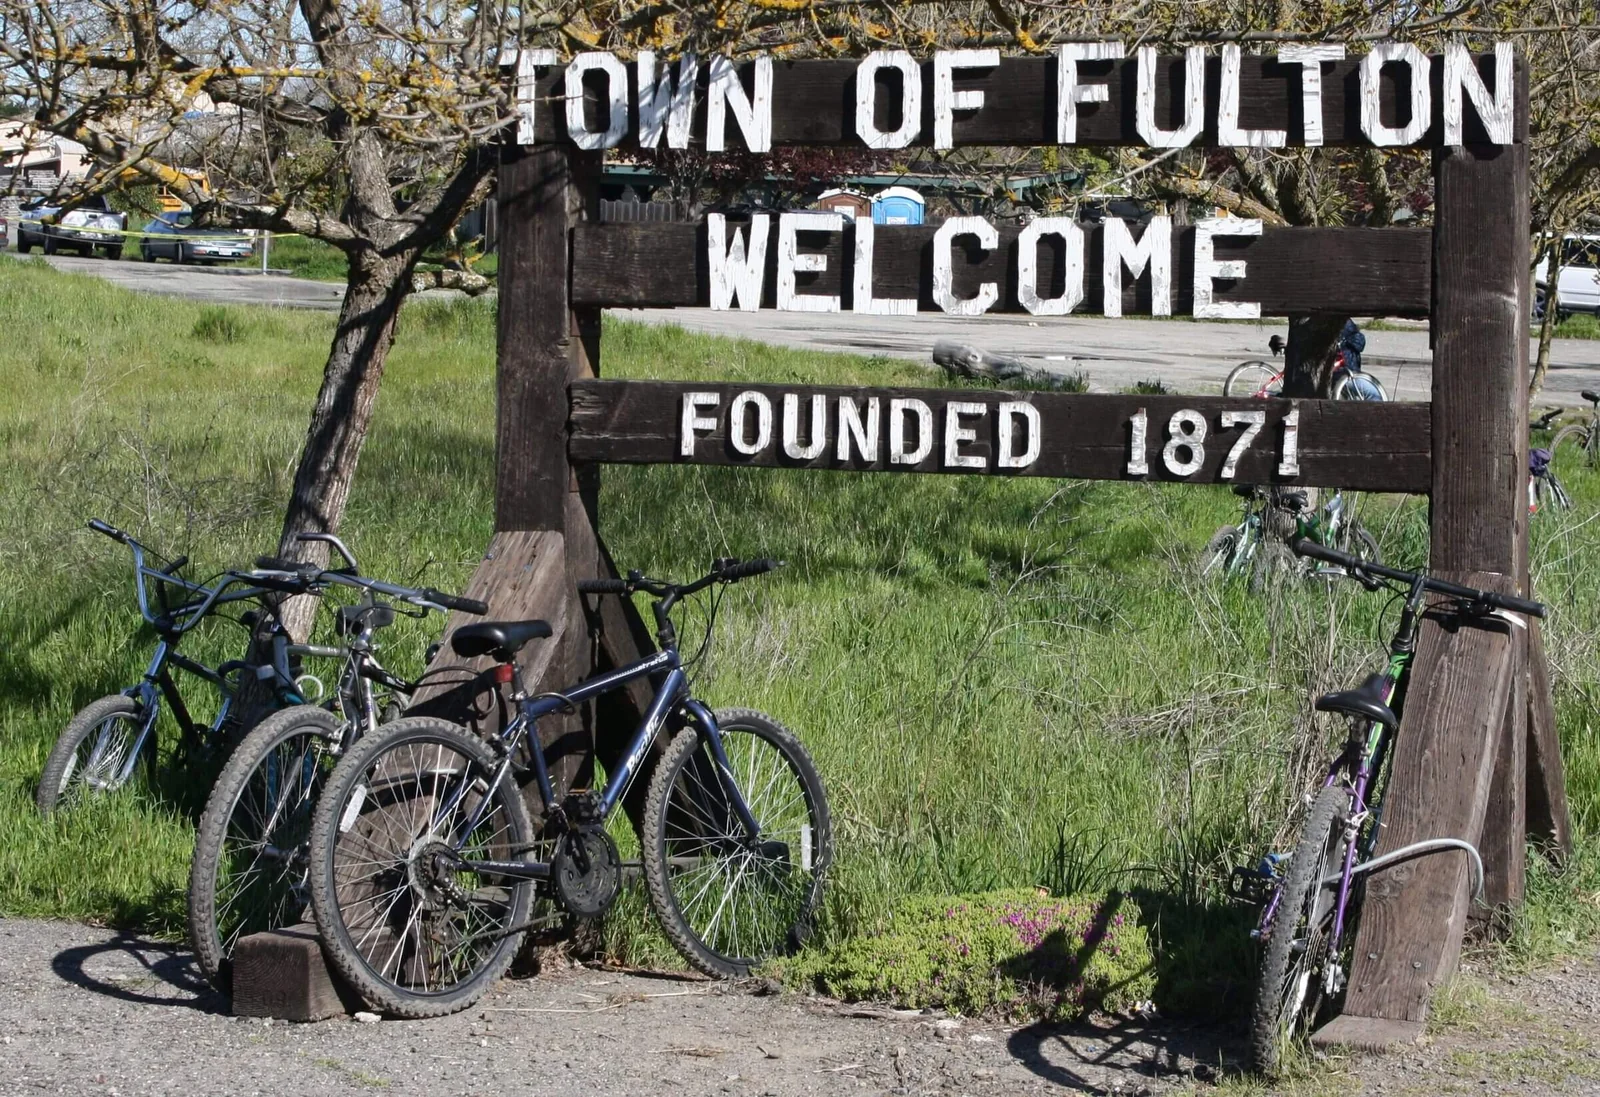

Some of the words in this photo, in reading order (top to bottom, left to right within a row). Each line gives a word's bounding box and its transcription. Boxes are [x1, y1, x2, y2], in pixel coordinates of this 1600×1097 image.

[500, 49, 773, 153] TOWN
[855, 50, 1001, 150] OF
[1056, 42, 1514, 149] FULTON
[707, 212, 1264, 320] WELCOME
[680, 391, 1042, 470] FOUNDED
[1126, 406, 1301, 479] 1871
